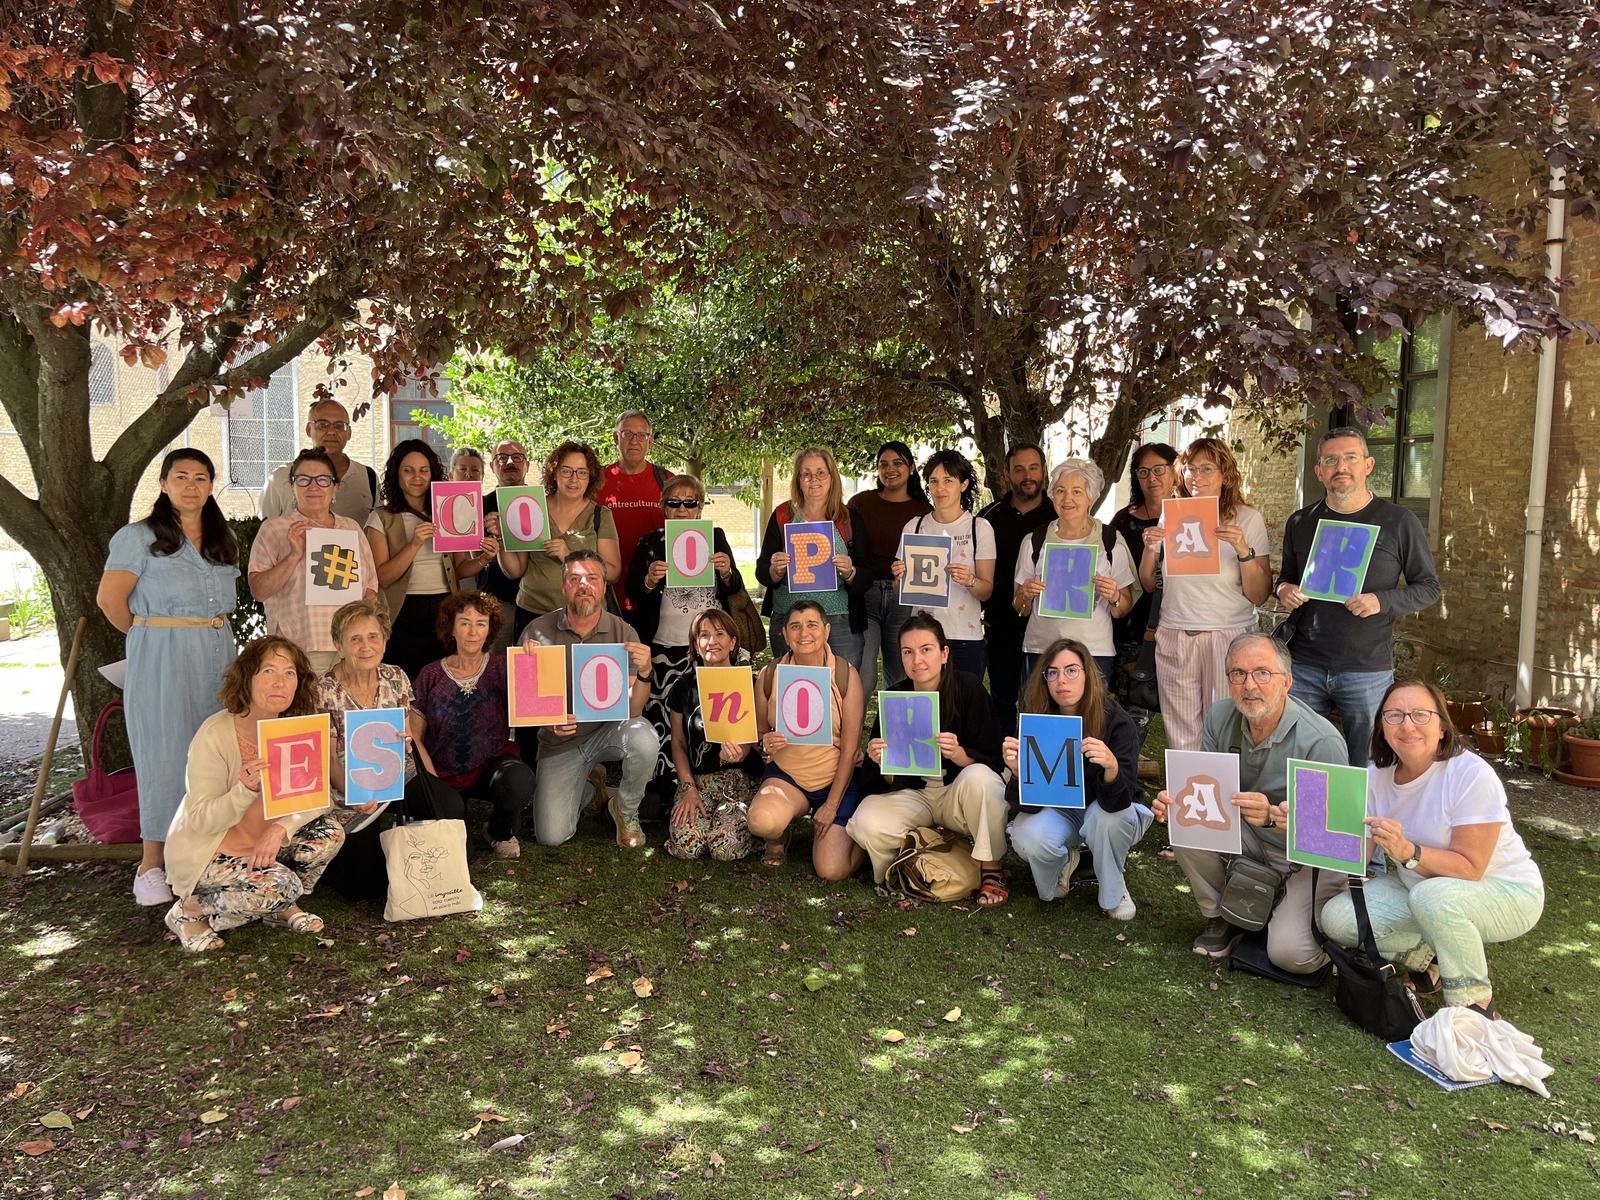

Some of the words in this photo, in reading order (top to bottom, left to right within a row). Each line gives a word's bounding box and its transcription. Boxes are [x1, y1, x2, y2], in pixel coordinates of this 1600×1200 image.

[440, 493, 476, 535] C
[506, 495, 545, 542] O
[1176, 522, 1209, 553] A
[672, 529, 709, 578] O
[790, 533, 832, 584] P
[910, 553, 940, 587] E
[1044, 548, 1092, 613] R
[1304, 526, 1371, 597] R
[514, 653, 563, 717] L
[578, 654, 623, 711] O
[782, 678, 825, 737] O
[350, 721, 402, 791] S
[883, 696, 935, 769] R
[1023, 735, 1080, 787] M
[274, 738, 317, 797] E
[1183, 782, 1226, 823] A
[1294, 767, 1362, 863] L
